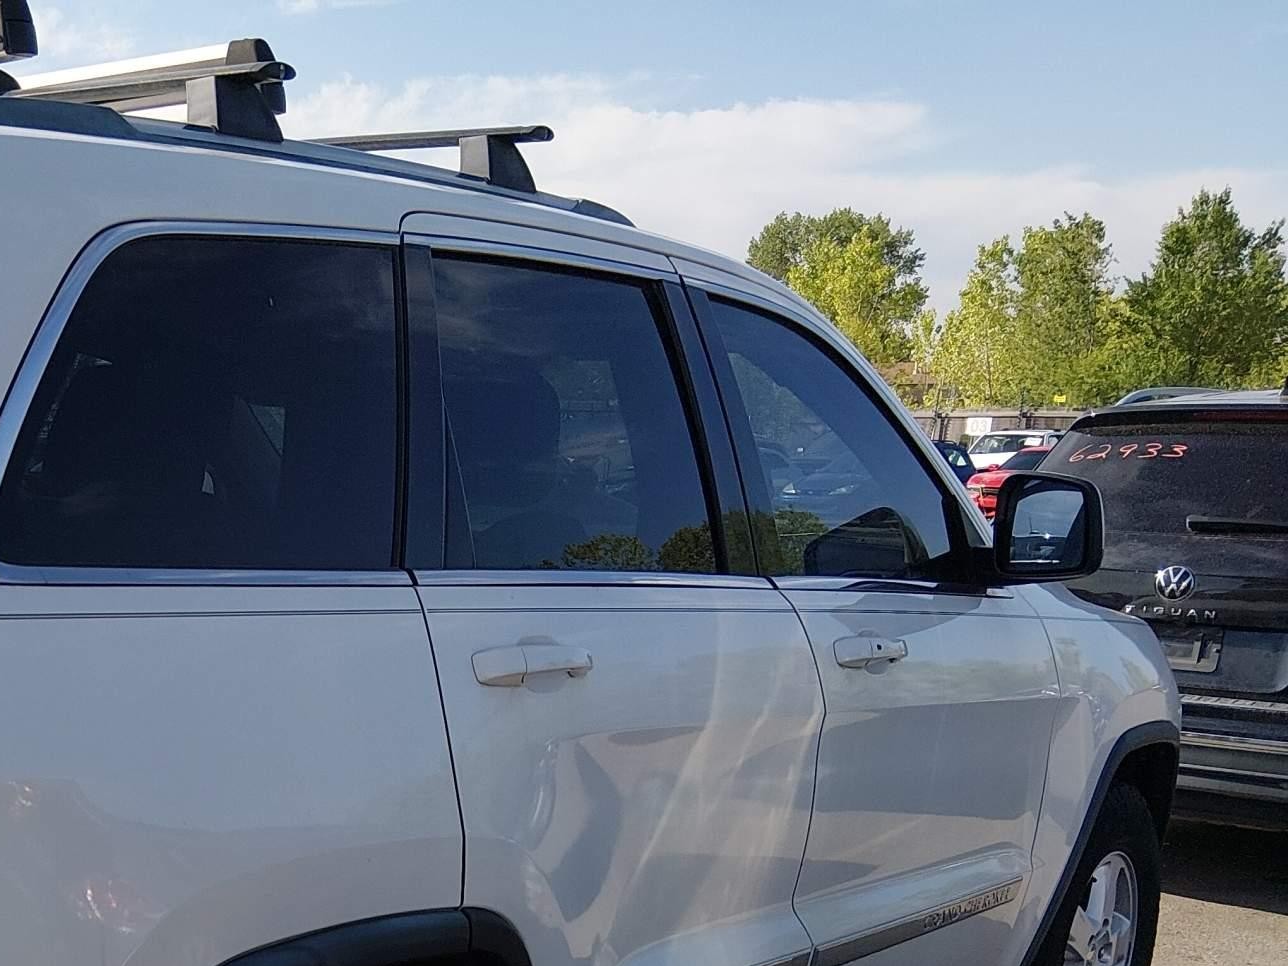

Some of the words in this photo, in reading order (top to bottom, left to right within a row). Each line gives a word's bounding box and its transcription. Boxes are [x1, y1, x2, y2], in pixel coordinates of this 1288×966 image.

[970, 419, 988, 433] 03
[1068, 443, 1189, 463] 62933
[1124, 604, 1217, 619] TIGUAN
